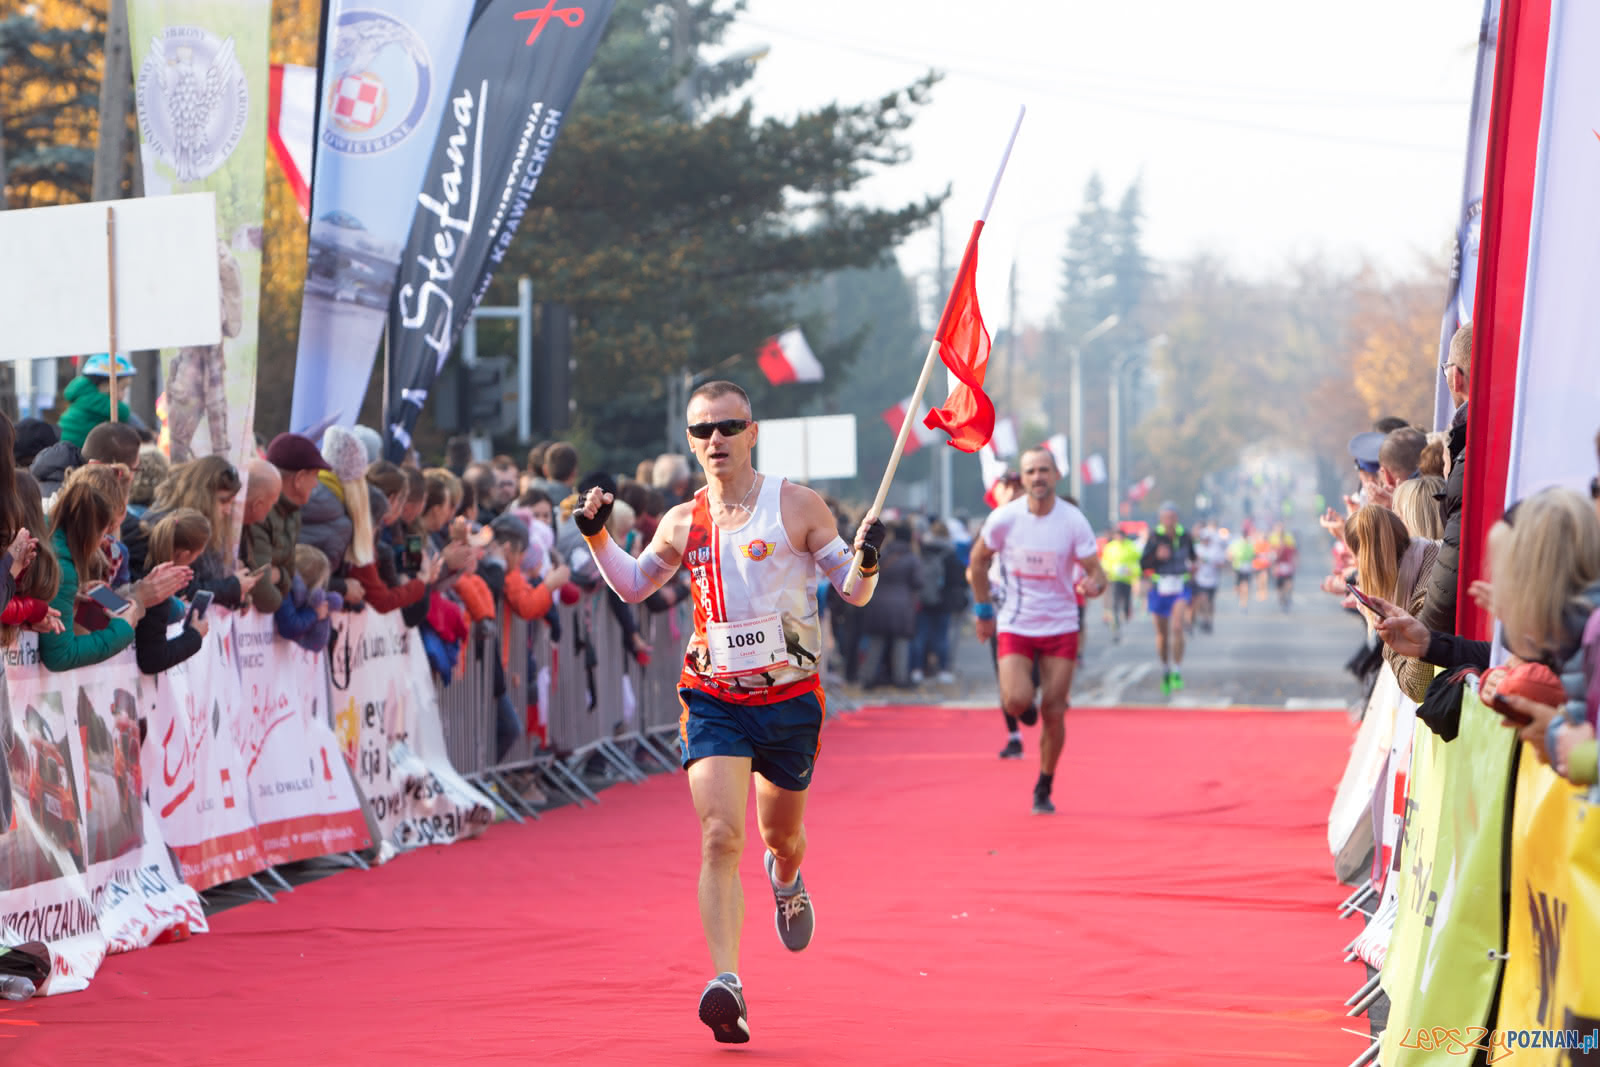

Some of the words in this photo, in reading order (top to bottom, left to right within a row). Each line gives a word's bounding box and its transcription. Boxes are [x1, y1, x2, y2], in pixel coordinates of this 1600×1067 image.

[399, 80, 488, 377] Stefana
[490, 108, 562, 264] KRAWIECKICH
[726, 631, 765, 649] 1080
